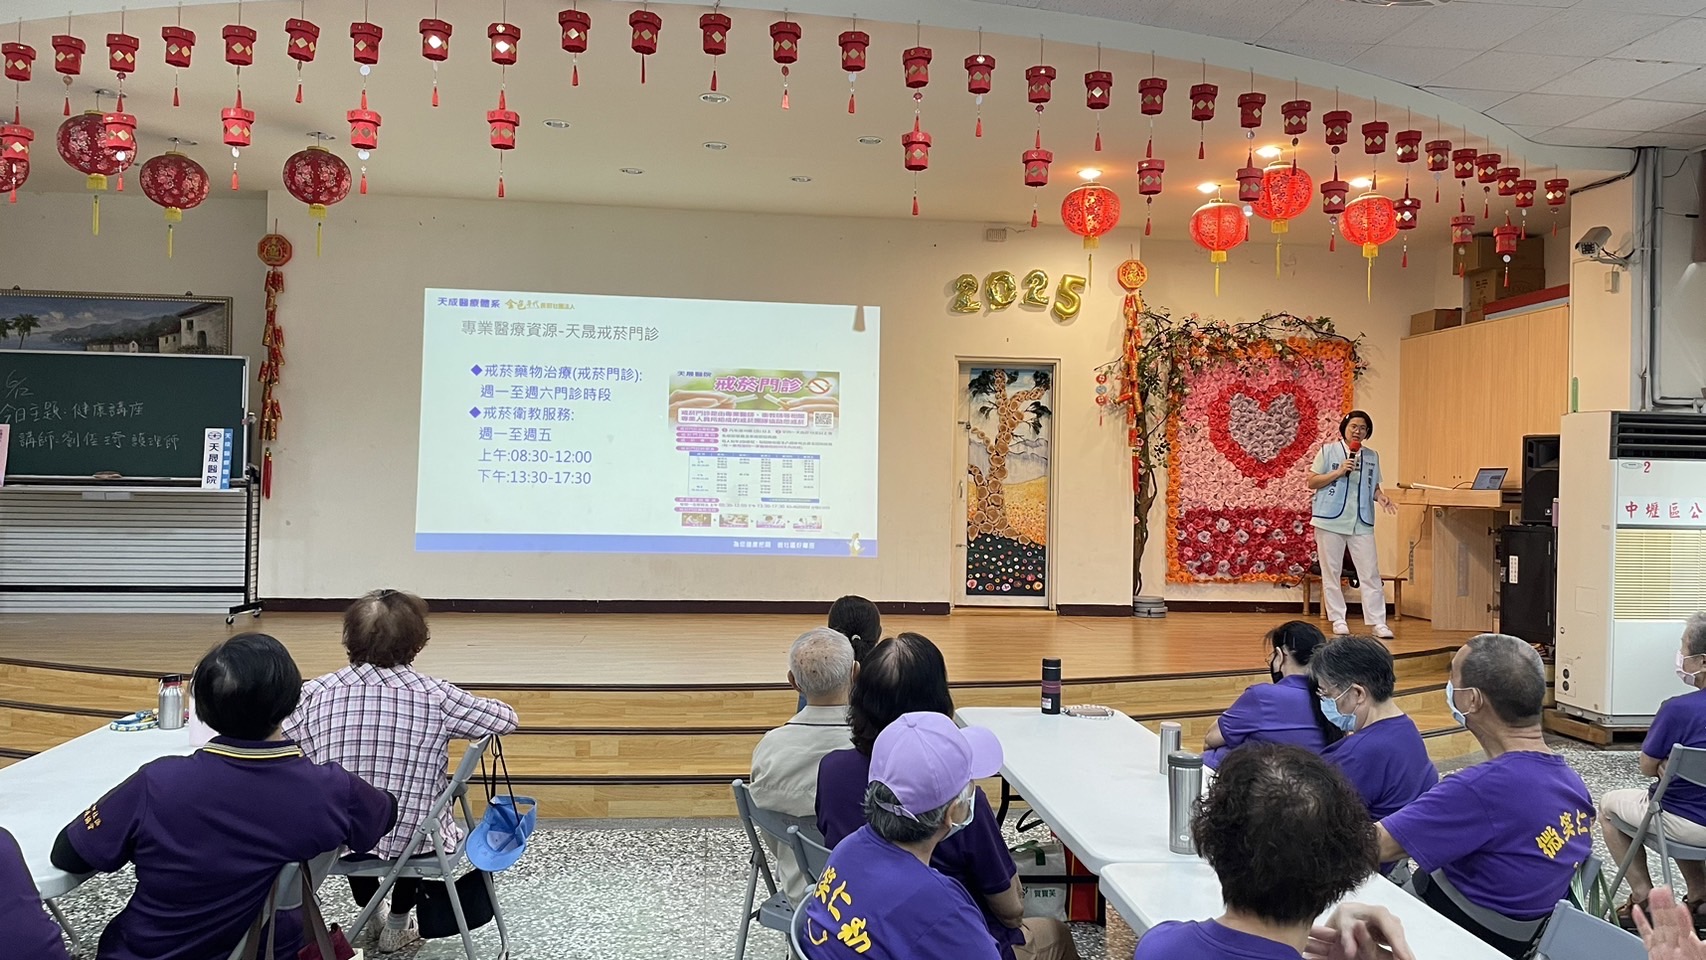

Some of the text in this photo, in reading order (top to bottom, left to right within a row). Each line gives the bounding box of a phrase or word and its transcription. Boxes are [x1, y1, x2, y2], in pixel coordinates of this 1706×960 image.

[950, 268, 1087, 321] 2025
[461, 320, 660, 342] 專業醫療資源-天晟戒菸門診
[480, 384, 612, 401] 週一至週六門診時段
[714, 376, 802, 393] 戒菸門診
[482, 406, 575, 421] 戒菸衛教服務:
[478, 426, 552, 442] 週一至週五
[206, 443, 220, 484] 天晟醫院
[1643, 461, 1652, 474] 2
[1625, 501, 1703, 519] 中壢區公
[1535, 809, 1592, 859] 微笑仁
